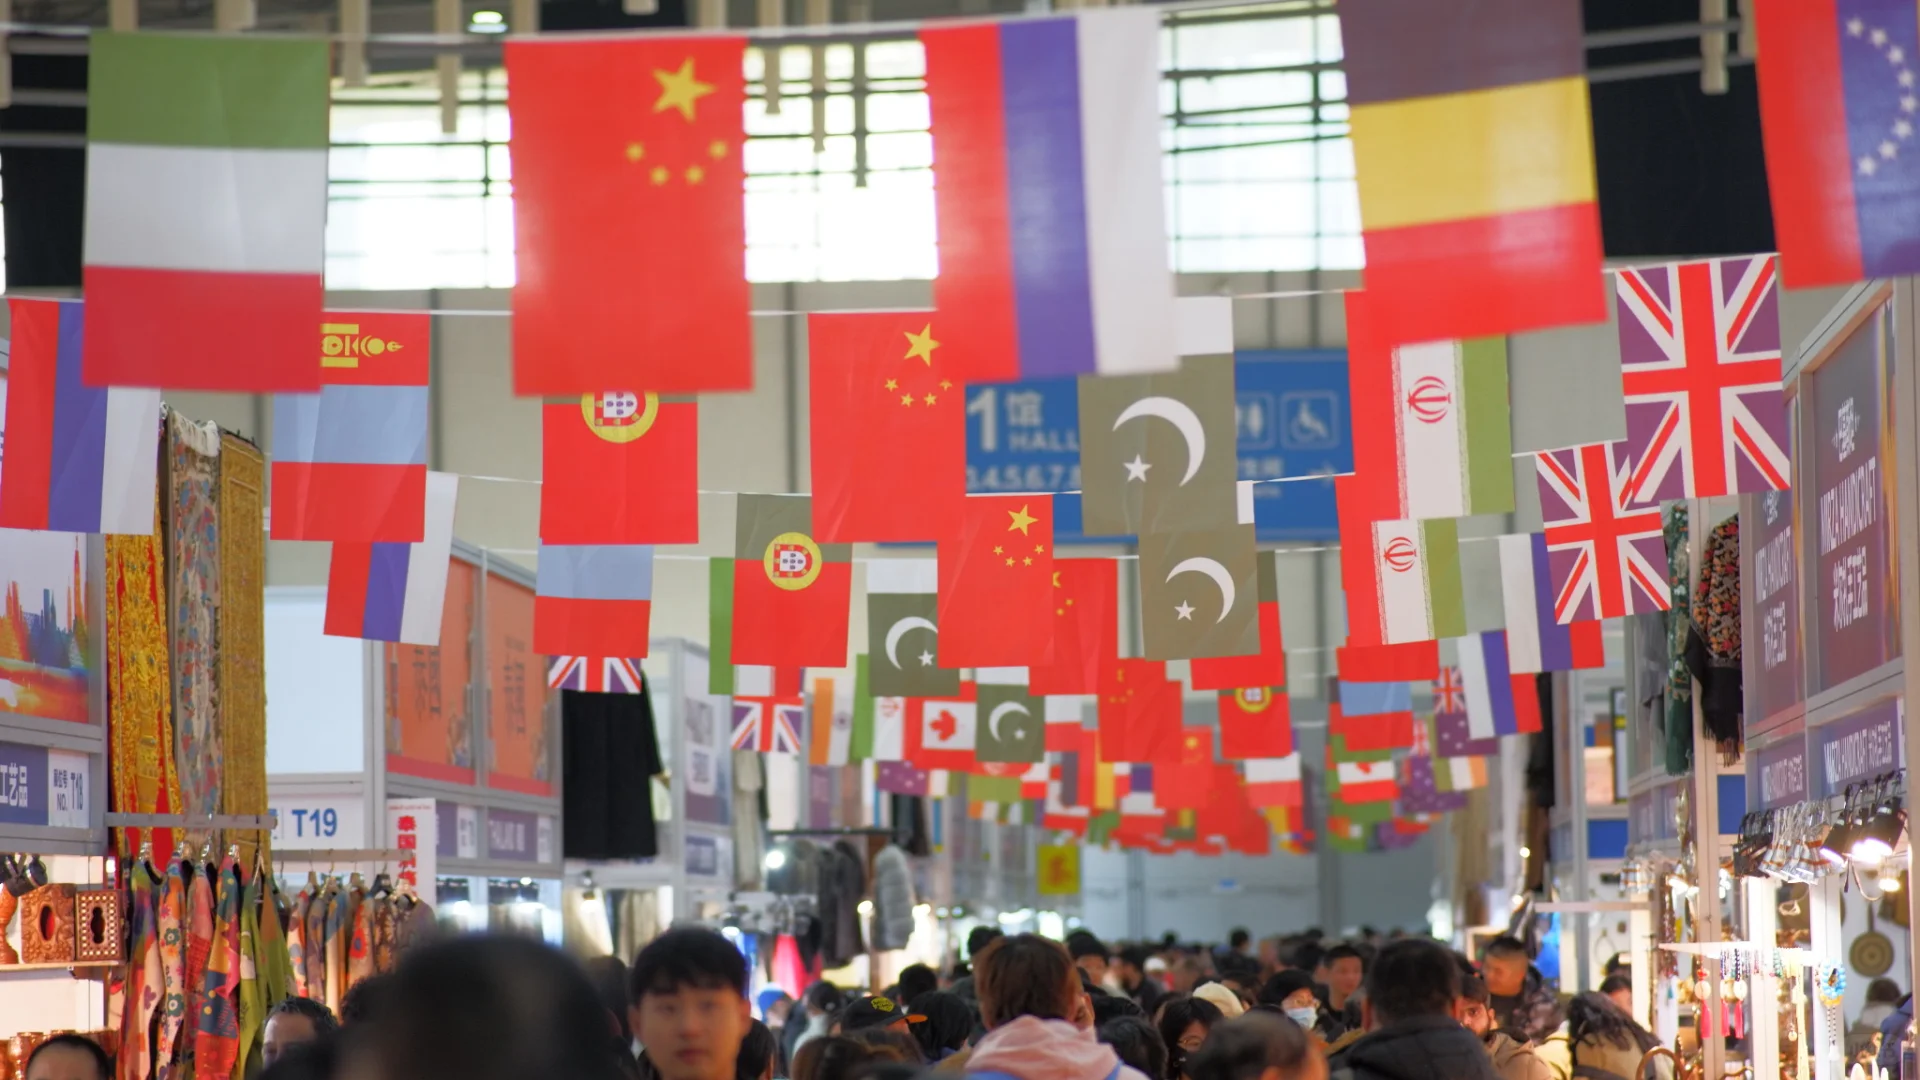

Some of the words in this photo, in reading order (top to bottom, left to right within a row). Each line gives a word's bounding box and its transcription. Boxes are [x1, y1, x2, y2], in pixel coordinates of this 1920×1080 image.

[967, 388, 996, 451] 1
[1009, 431, 1080, 452] HALL
[1840, 456, 1876, 546] HANDICRAFT
[291, 807, 338, 837] T19
